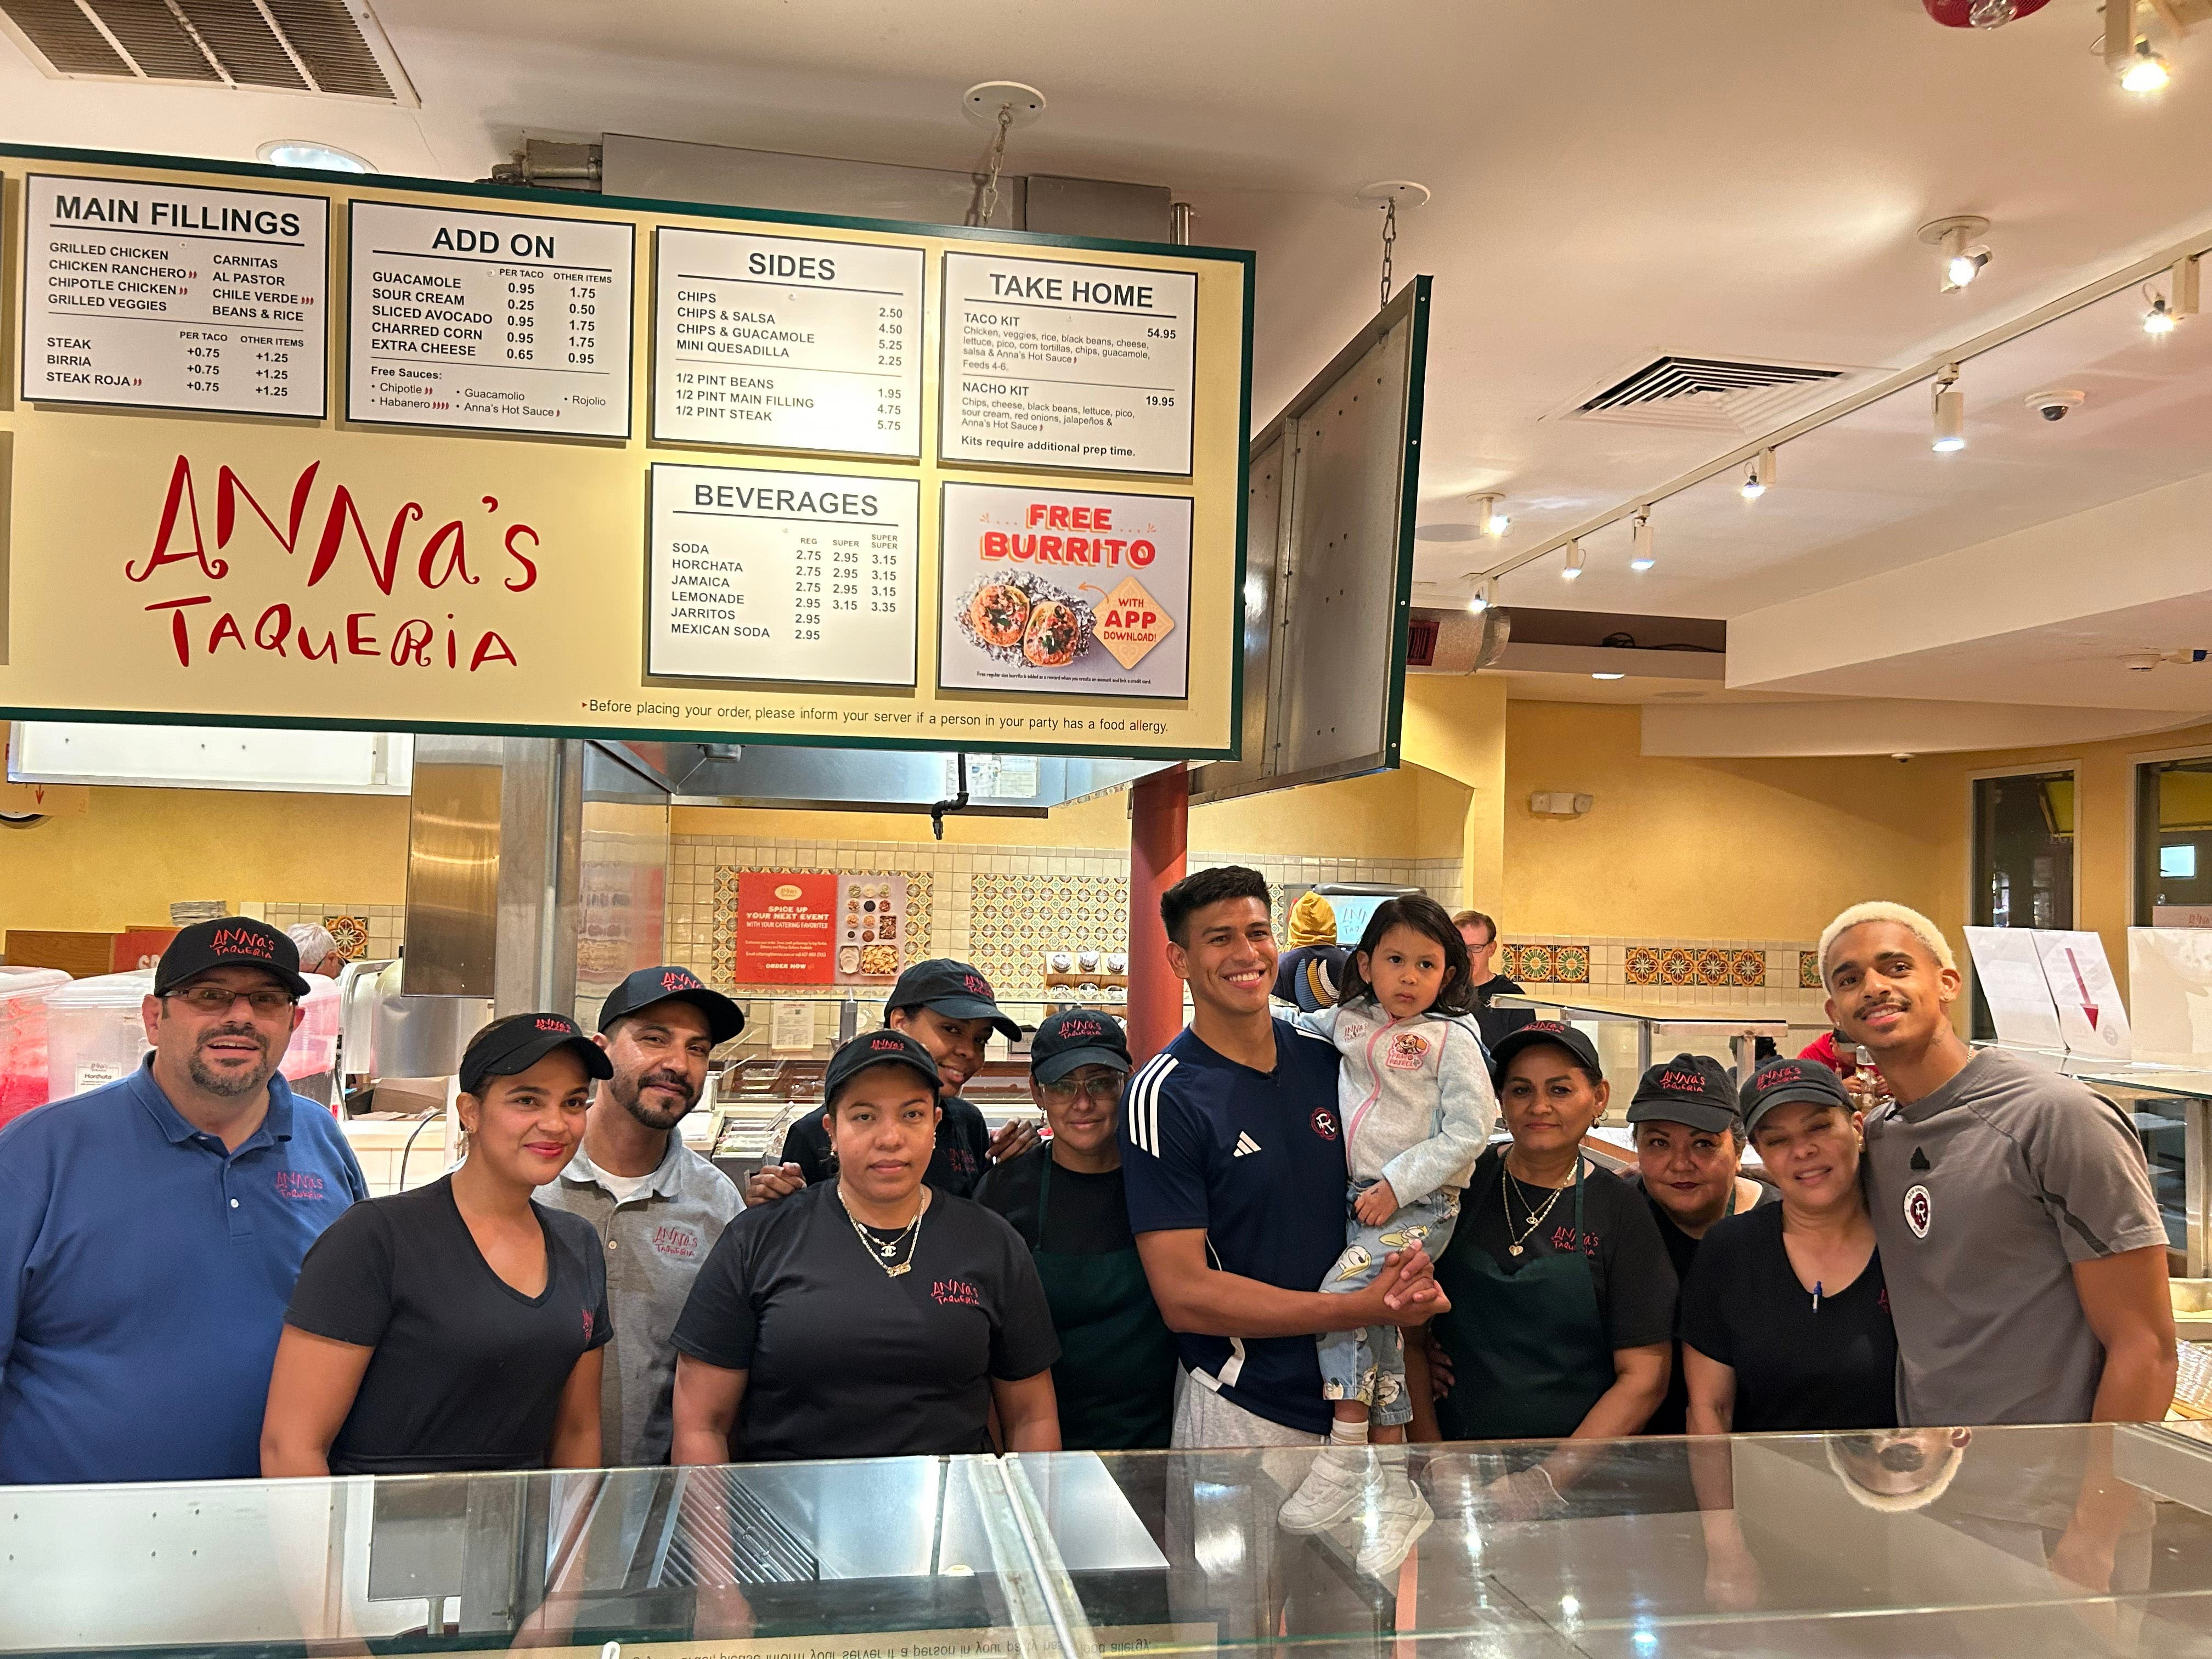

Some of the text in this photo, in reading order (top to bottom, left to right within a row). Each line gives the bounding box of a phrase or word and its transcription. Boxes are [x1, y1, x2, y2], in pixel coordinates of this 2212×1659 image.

[57, 195, 300, 236] MAIN FILLINGS
[49, 242, 169, 261] GRILLED CHICKEN
[431, 227, 555, 259] ADD ON
[49, 259, 187, 279] CHICKEN RANCHERO
[213, 254, 278, 269] CARNITAS
[748, 252, 836, 281] SIDES
[48, 276, 177, 295] CHIPOTLE CHICKEN
[213, 272, 285, 286] AL PASTOR
[372, 271, 596, 299] GUACAMOLE 0.95 1.75
[213, 288, 298, 304] CHILE VERDE
[372, 288, 534, 311] SOUR CREAM 0.25
[990, 273, 1153, 308] TAKE HOME
[48, 294, 167, 312] GRILLED VEGGIES
[677, 290, 903, 319] CHIPS 2.50
[213, 305, 304, 322] BEANS & RICE
[371, 304, 493, 324] SLICED AVOCADO
[732, 311, 902, 335] SALSA 4.50
[371, 321, 482, 340] CHARRED CORN
[676, 323, 815, 344] CHIPS & GUACAMOLE
[964, 312, 1176, 340] TACO KIT 54.95
[180, 331, 304, 348] PER TACO OTHER ITEMS
[964, 325, 1149, 349] Chicken, veggies, rice, black beans, cheese,
[47, 337, 289, 363] STEAK +0.75 +1.25
[371, 338, 476, 357] EXTRA CHEESE
[676, 339, 790, 358] MINI QUESADILLA
[964, 336, 994, 347] lettuce,
[997, 341, 1017, 349] pico,
[1041, 343, 1073, 354] tortillas,
[1075, 346, 1100, 357] chips,
[1102, 349, 1150, 360] guacamole,
[47, 354, 92, 367] BIRRIA
[963, 359, 990, 370] Feeds
[371, 365, 442, 380] Free Sauces:
[676, 373, 774, 390] 1/2 PINT BEANS
[380, 382, 422, 394] Chipotle
[464, 388, 606, 407] Guacamolio Rojolio
[963, 381, 1175, 407] NACHO KIT 19.95
[380, 396, 431, 409] Habanero
[464, 402, 554, 417] Anna's Hot Sauce
[730, 393, 814, 409] MAIN FILLING
[983, 410, 1012, 420] cream,
[1030, 414, 1062, 424] onions,
[1063, 416, 1104, 426] jalapeños
[962, 435, 1136, 457] Kits require additional prep time.
[696, 484, 878, 517] BEVERAGES
[1026, 504, 1112, 533] FREE
[833, 539, 860, 548] SUPER
[980, 532, 1155, 569] BURRITO
[673, 542, 897, 566] SODA 2.75 3.15
[673, 558, 744, 573] HORCHATA
[672, 574, 730, 588] JAMAICA
[672, 591, 896, 613] LEMONADE 3.35
[1118, 598, 1144, 608] WITH
[671, 607, 736, 620] JARRITOS
[1104, 610, 1156, 629] APP
[672, 623, 771, 638] MEXICAN SODA
[1103, 630, 1156, 642] DOWNLOAD!
[589, 699, 1168, 735] Before placing your order, please inform person party allergy.
